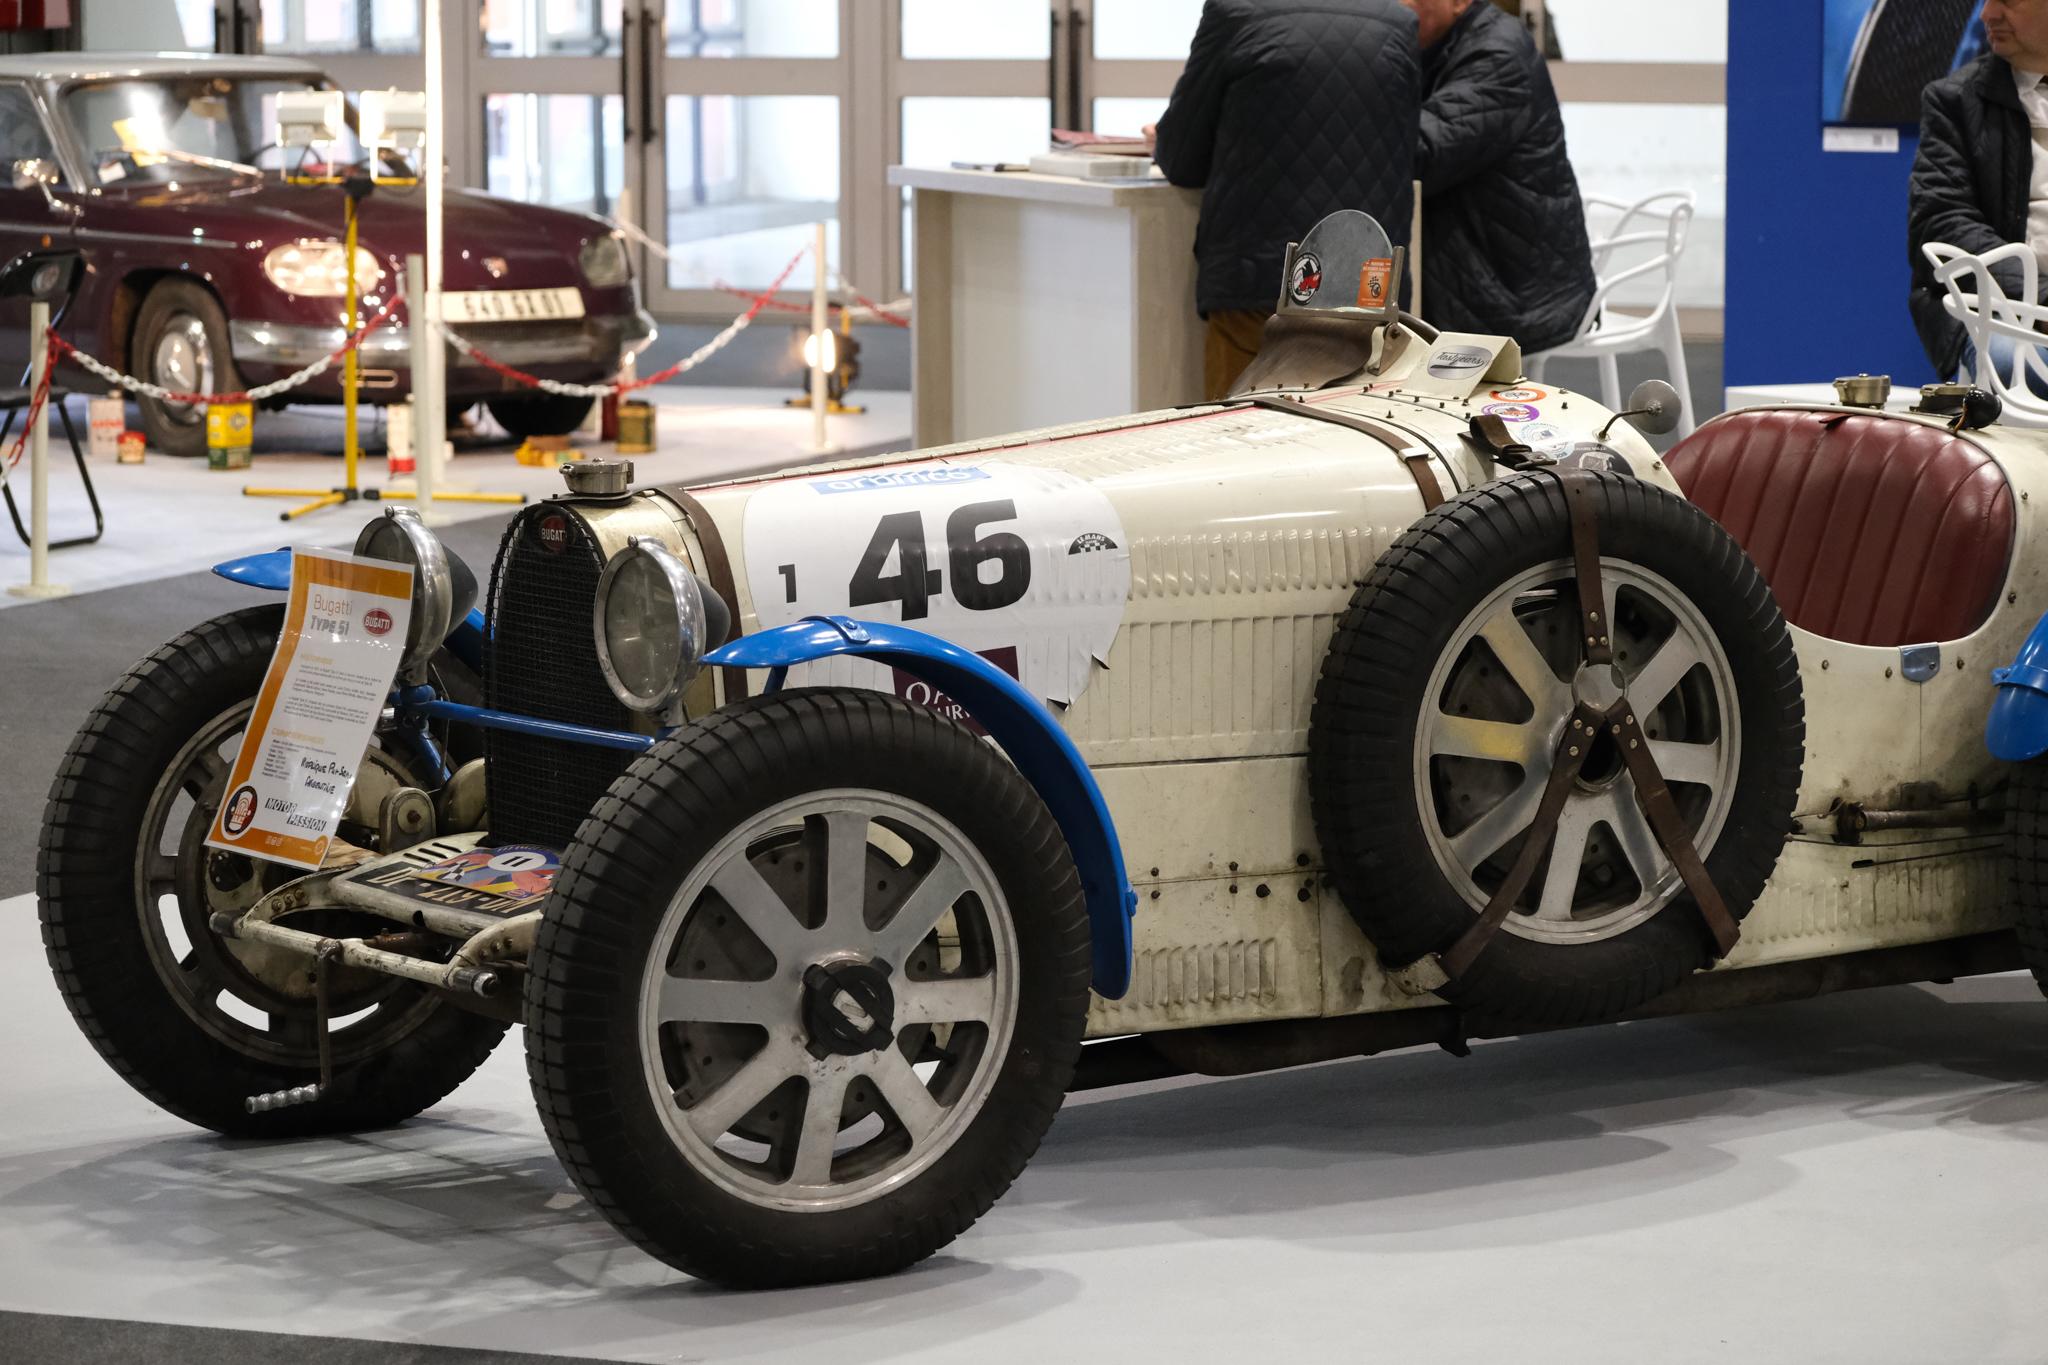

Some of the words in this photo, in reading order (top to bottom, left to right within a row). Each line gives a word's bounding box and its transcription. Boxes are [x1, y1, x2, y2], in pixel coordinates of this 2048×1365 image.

[541, 527, 568, 542] BUGAT
[849, 498, 1032, 621] 46
[778, 563, 797, 603] 1
[313, 594, 353, 616] Bugatti
[310, 615, 337, 633] TYPE
[364, 615, 391, 630] BUGATTI
[265, 798, 297, 814] MOTOR
[287, 813, 327, 832] PASSION
